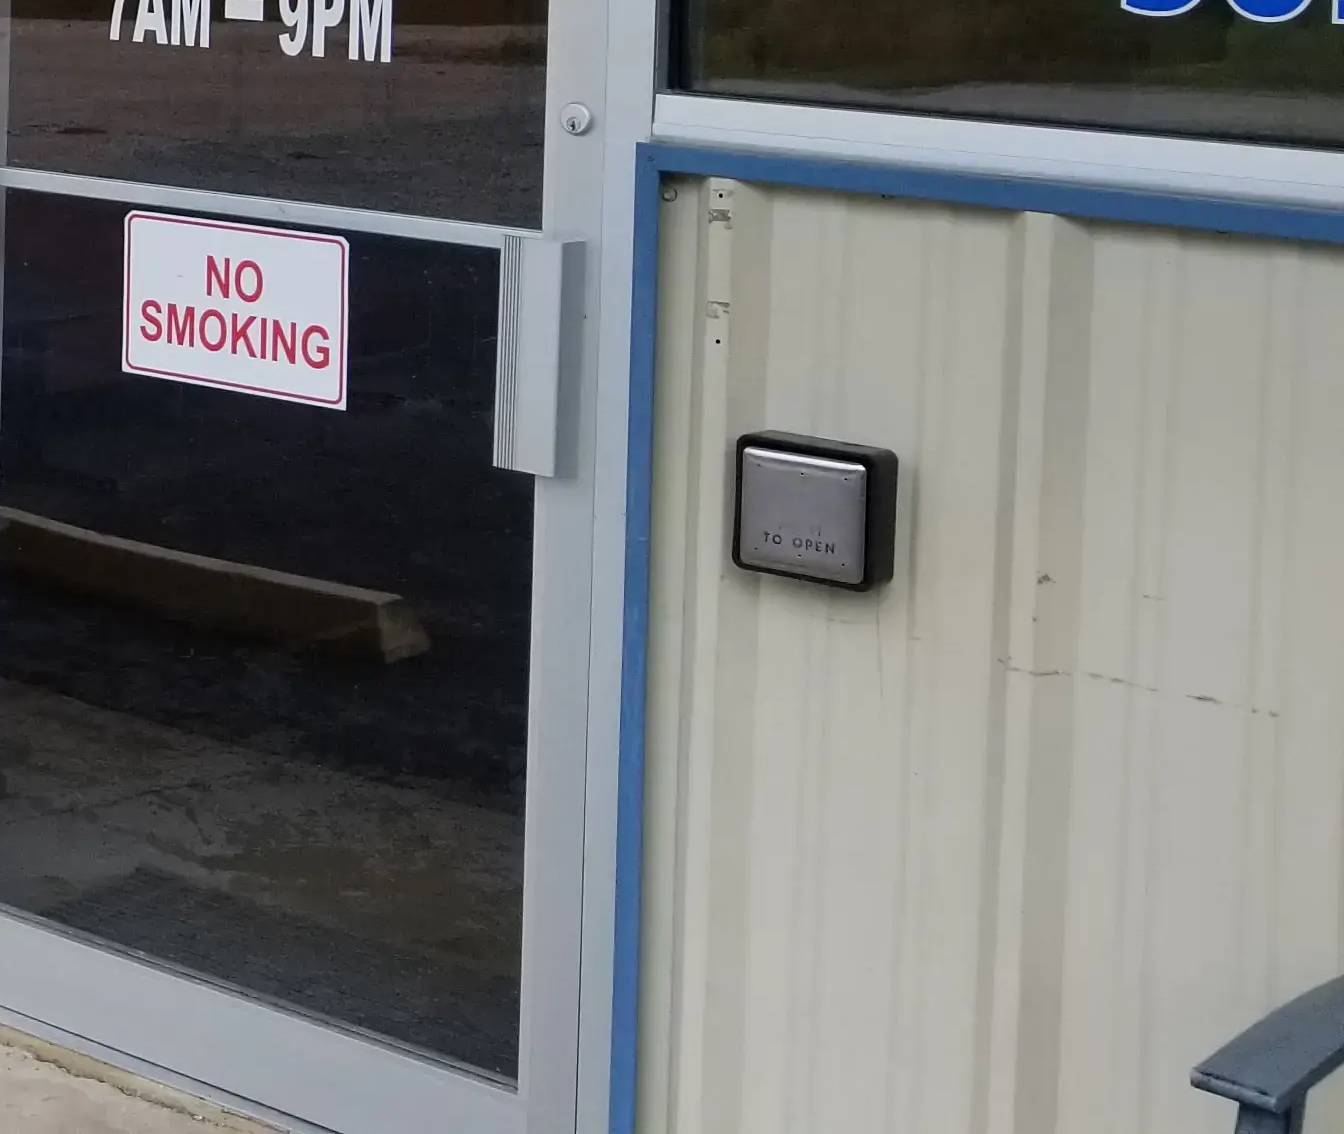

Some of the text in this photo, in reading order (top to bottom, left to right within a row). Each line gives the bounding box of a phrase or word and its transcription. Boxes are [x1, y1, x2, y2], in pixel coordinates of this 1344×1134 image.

[205, 254, 263, 303] NO
[139, 299, 331, 370] SMOKING
[764, 531, 835, 554] TO OPEN
